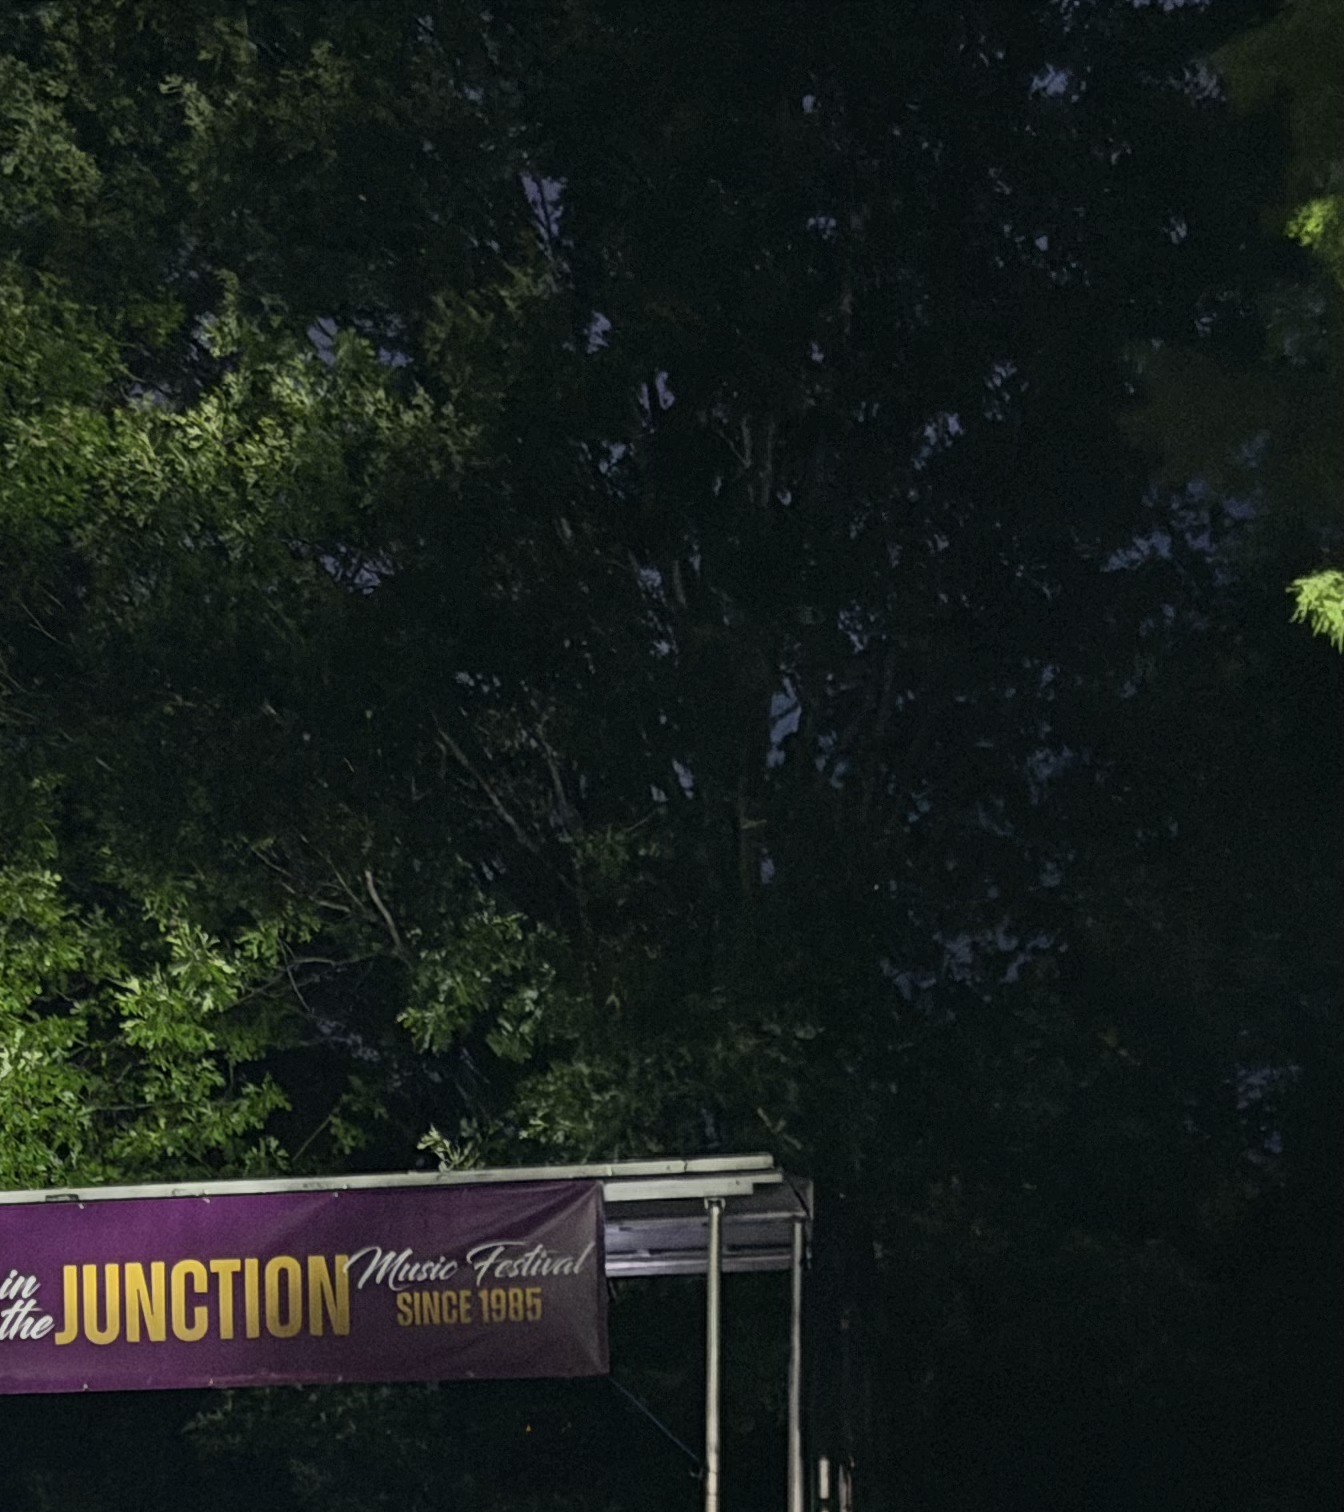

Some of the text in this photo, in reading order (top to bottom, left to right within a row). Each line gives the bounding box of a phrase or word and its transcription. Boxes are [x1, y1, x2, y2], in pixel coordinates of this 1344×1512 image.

[342, 1240, 596, 1292] Music Festival
[54, 1254, 350, 1346] JUNCTION
[396, 1286, 543, 1327] SINCE 1985
